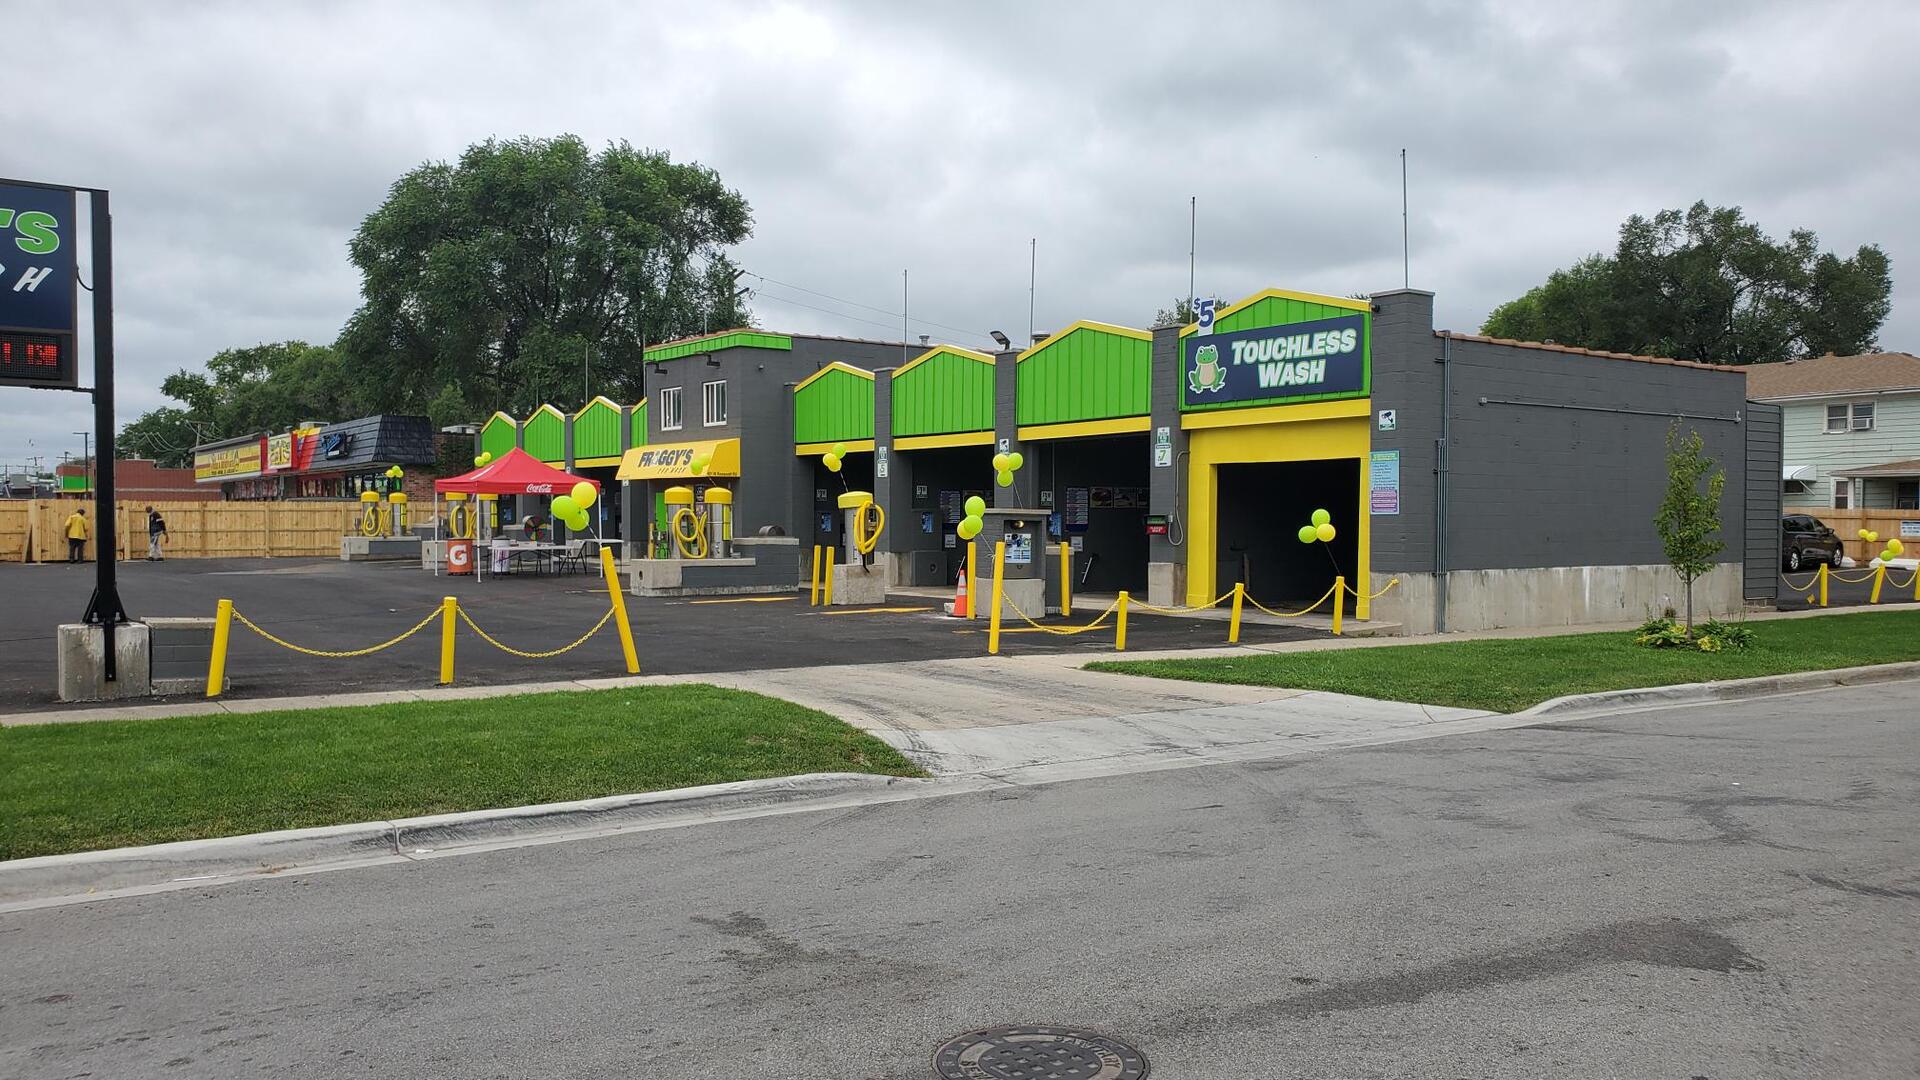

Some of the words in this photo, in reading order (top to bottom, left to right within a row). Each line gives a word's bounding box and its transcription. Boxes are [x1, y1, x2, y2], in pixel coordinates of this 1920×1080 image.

[1194, 297, 1214, 328] $5
[1231, 328, 1357, 366] TOUCHLESS
[1257, 358, 1327, 389] WASH
[449, 545, 468, 566] G
